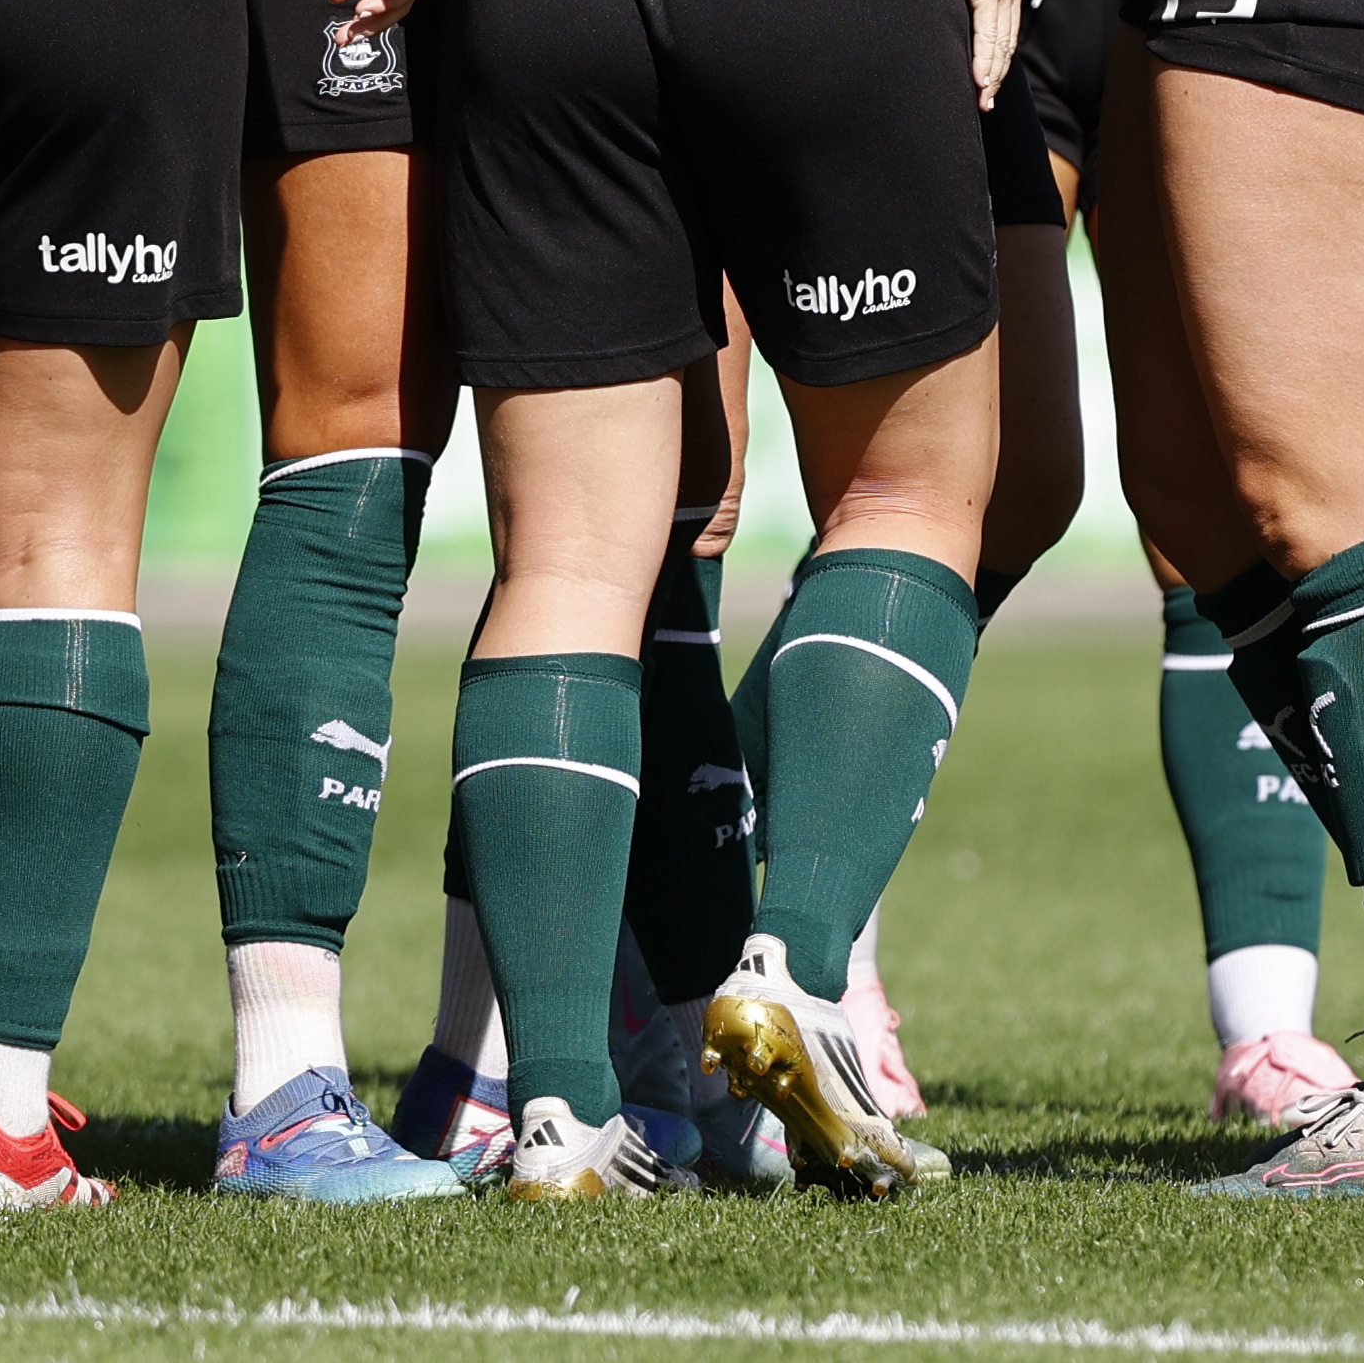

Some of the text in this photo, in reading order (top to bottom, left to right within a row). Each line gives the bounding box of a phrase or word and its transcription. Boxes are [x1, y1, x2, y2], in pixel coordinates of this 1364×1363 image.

[38, 232, 178, 284] tallyho
[783, 267, 917, 321] tallyho
[862, 295, 911, 315] coaches
